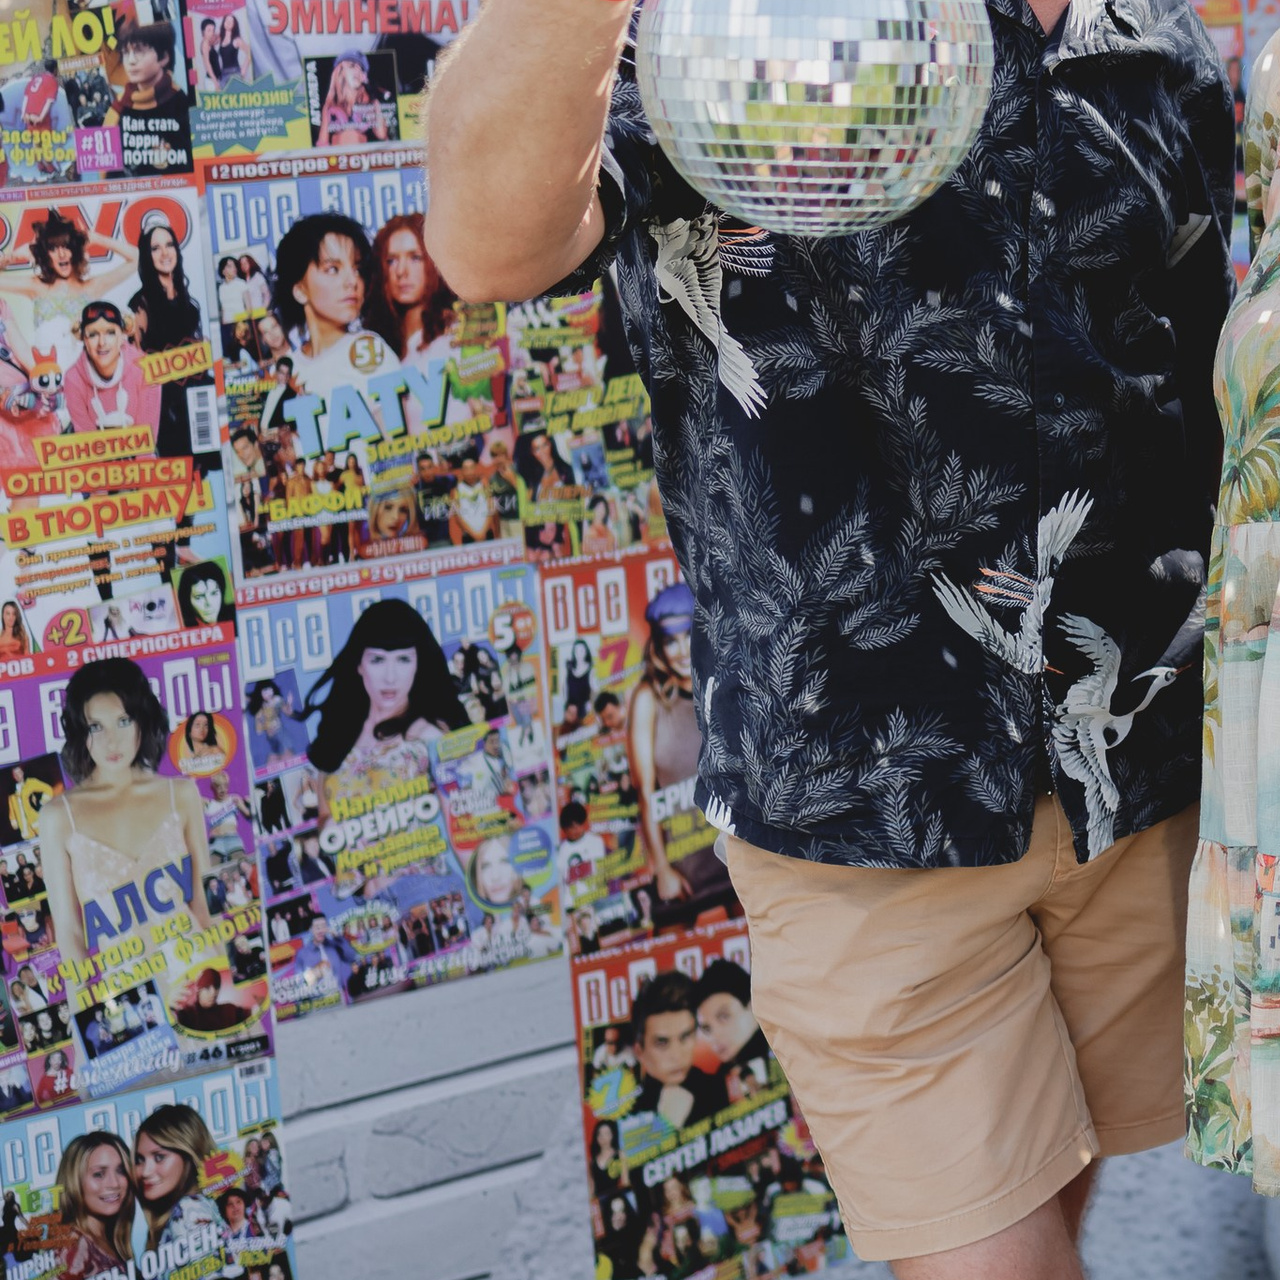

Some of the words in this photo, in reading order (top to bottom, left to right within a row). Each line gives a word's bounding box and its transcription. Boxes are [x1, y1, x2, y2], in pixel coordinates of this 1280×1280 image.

[51, 6, 118, 58] ЛО!
[81, 130, 113, 152] #81
[123, 115, 145, 132] Как
[147, 117, 180, 132] стать
[123, 132, 161, 149] Гарри
[232, 156, 329, 180] постеров
[354, 339, 384, 365] 5!
[283, 357, 452, 461] ТАТУ
[40, 430, 152, 466] Ранетки
[7, 459, 188, 498] отправятся
[8, 516, 30, 543] в
[35, 471, 206, 538] тюрьму!
[16, 552, 43, 570] Они
[46, 541, 119, 564] признались
[133, 522, 216, 547] шокирующих
[25, 577, 92, 600] планируют
[256, 568, 361, 601] постеров
[47, 610, 88, 648] +2
[67, 648, 80, 668] 2
[82, 625, 224, 663] СУПЕРПОСТЕРА
[493, 612, 516, 650] 5
[319, 793, 441, 854] ОРЕЙРО
[83, 853, 194, 950] АЛСУ
[75, 952, 168, 1011] письма
[204, 1152, 237, 1179] 5
